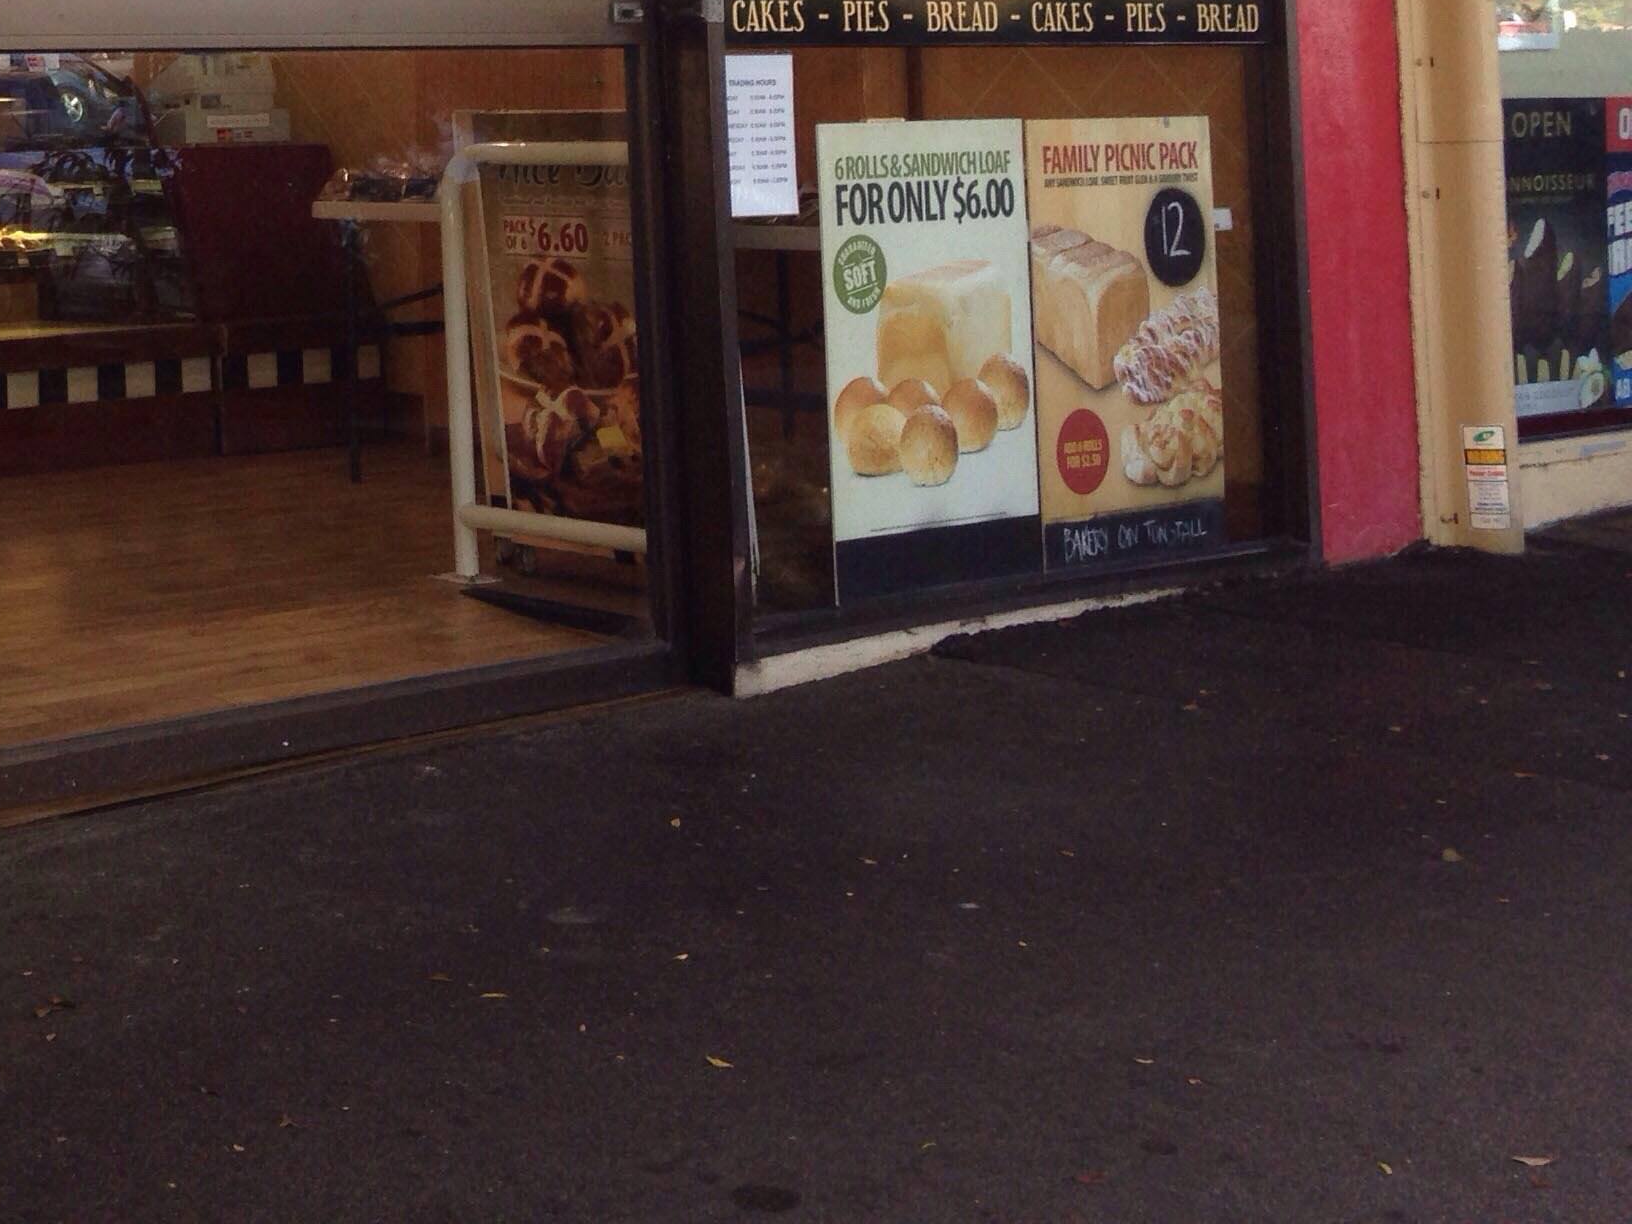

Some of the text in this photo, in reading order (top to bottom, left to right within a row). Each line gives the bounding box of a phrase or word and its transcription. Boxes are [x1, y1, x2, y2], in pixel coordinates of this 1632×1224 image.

[732, 0, 805, 32] CAKES
[843, 0, 889, 32] PIES
[926, 0, 998, 32] BREAD
[1031, 2, 1094, 32] CAKES
[1126, 3, 1166, 32] PIES
[1197, 3, 1258, 32] BREAD
[1511, 111, 1571, 138] OPEN
[835, 157, 844, 180] 6
[846, 154, 889, 179] ROLLS
[903, 151, 977, 177] SANDWICH
[979, 150, 1011, 174] LOAF
[1042, 141, 1198, 174] FAMILY PICNIC PACK
[1509, 173, 1596, 192] NNOISSEUR
[835, 176, 1014, 226] FOR ONLY $6.00
[504, 219, 526, 233] PACK
[843, 260, 878, 291] SOFT
[1119, 524, 1138, 549] ON
